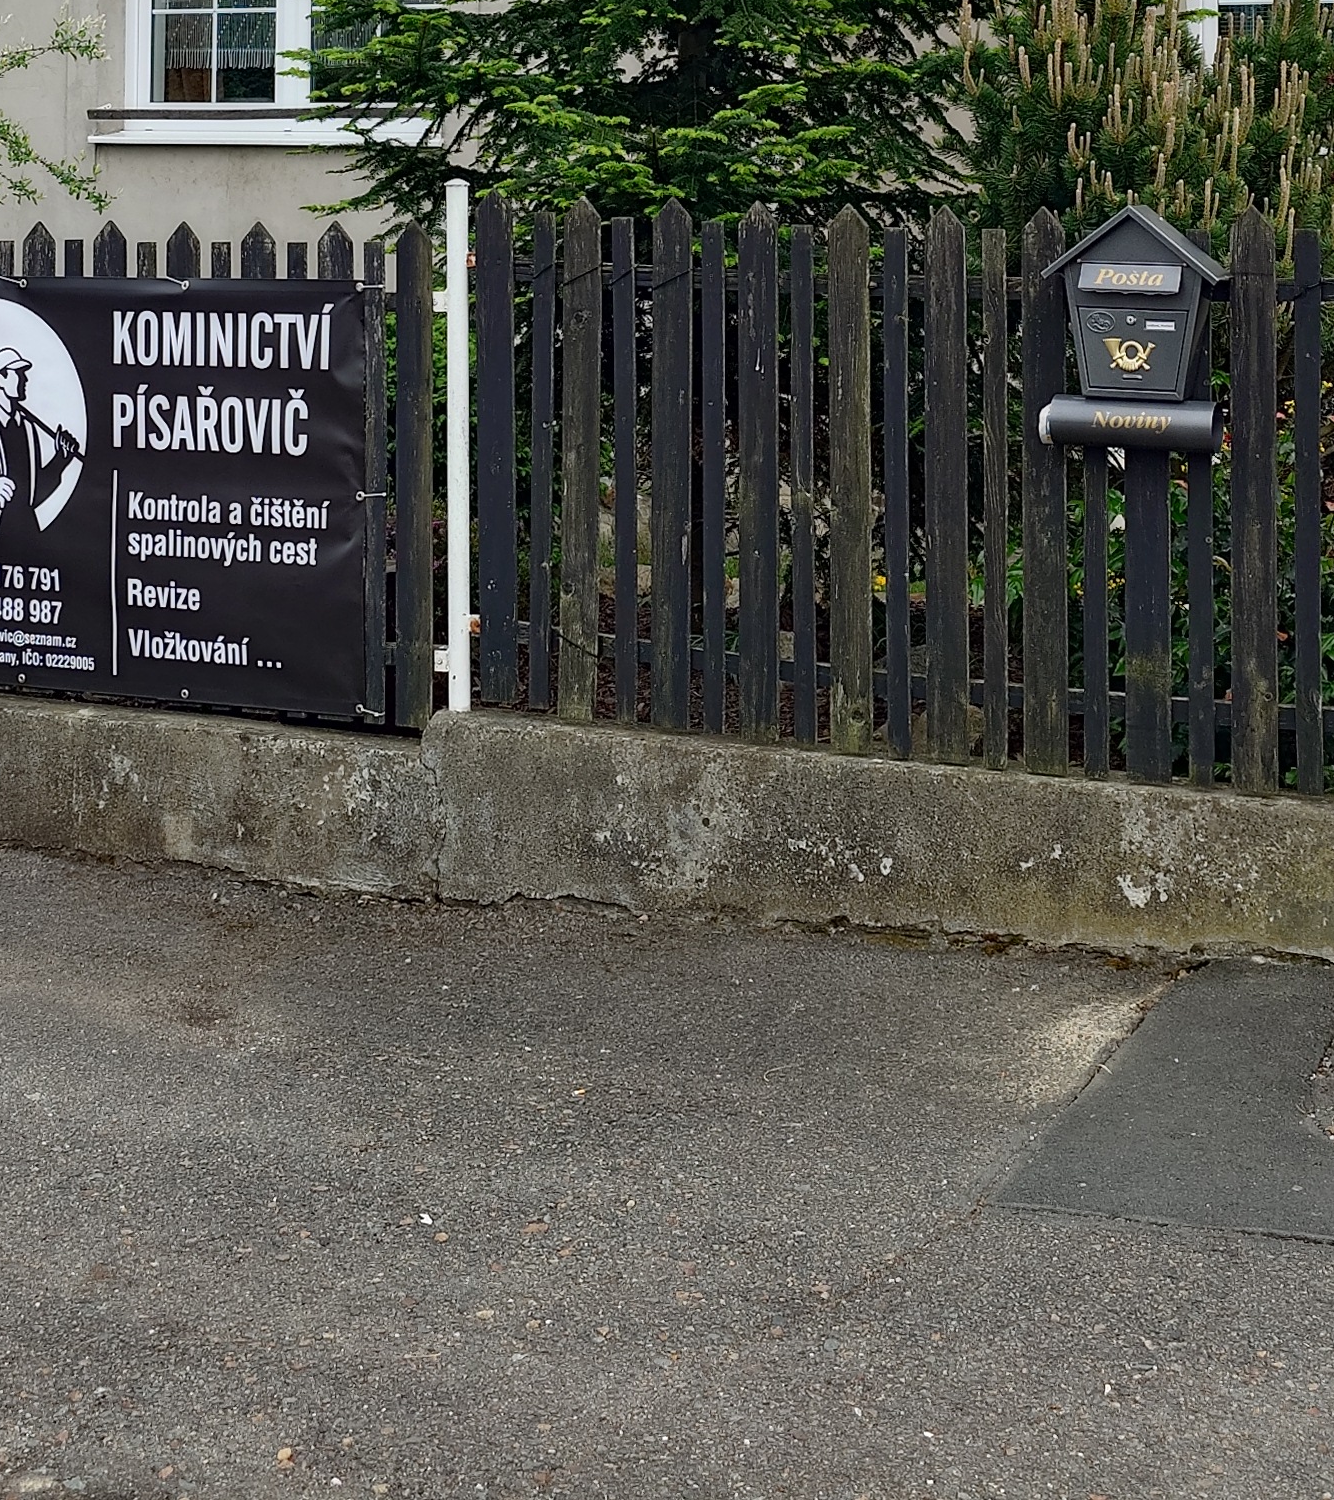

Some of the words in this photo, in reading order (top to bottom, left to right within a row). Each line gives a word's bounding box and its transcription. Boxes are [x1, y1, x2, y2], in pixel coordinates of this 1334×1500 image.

[1094, 268, 1164, 287] Pošta
[113, 303, 335, 370] KOMINICTVÍ
[113, 384, 309, 457] PÍSAŘOVIČ
[1091, 411, 1172, 434] Noviny
[128, 491, 221, 524] Kontrola
[228, 502, 242, 525] a
[250, 497, 330, 529] čištění
[128, 529, 262, 567] spalinových
[269, 538, 317, 566] cest
[28, 567, 60, 592] 791
[127, 578, 201, 611] Revize
[29, 599, 62, 624] 987
[22, 649, 44, 667] IČO:
[45, 655, 95, 671] 02229005
[128, 628, 250, 666] Vložkování
